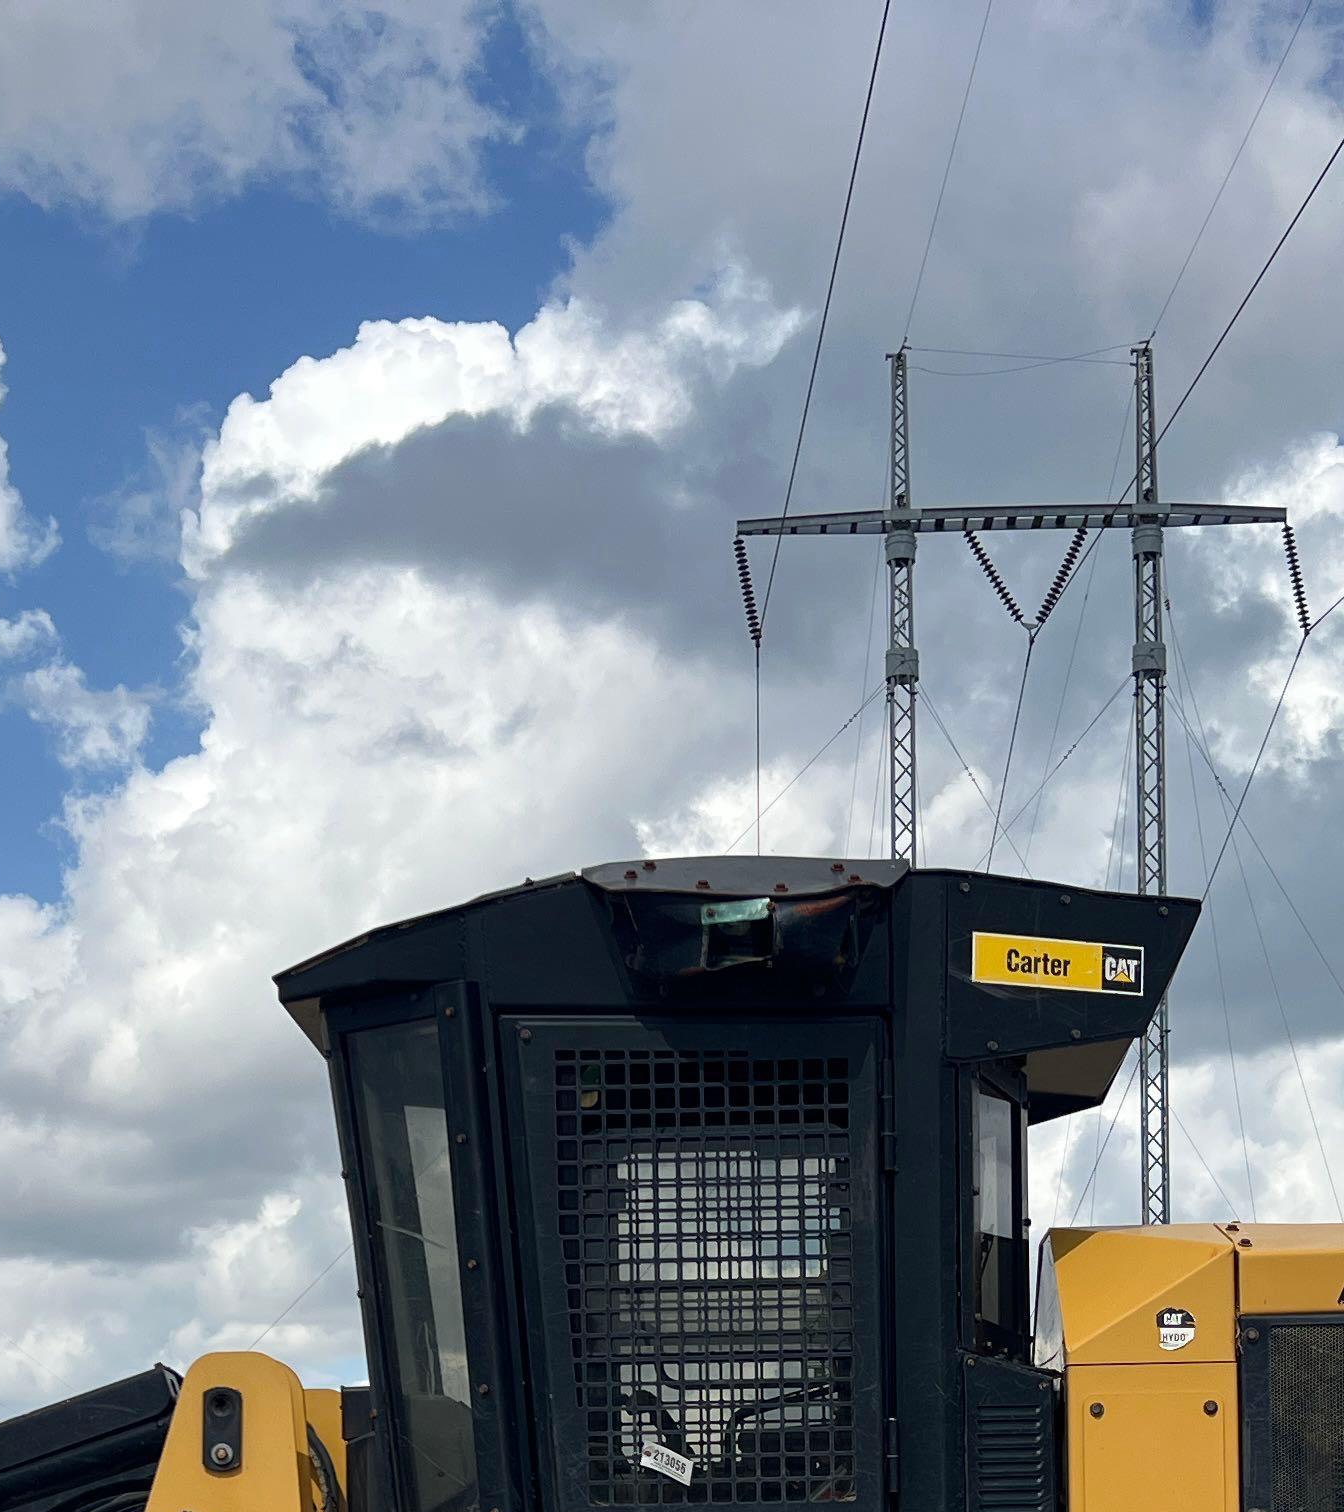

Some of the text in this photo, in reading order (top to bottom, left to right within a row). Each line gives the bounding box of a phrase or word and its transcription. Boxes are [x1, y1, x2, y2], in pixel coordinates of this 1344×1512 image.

[1006, 948, 1139, 983] Carter CAT
[1163, 1313, 1183, 1326] CAT
